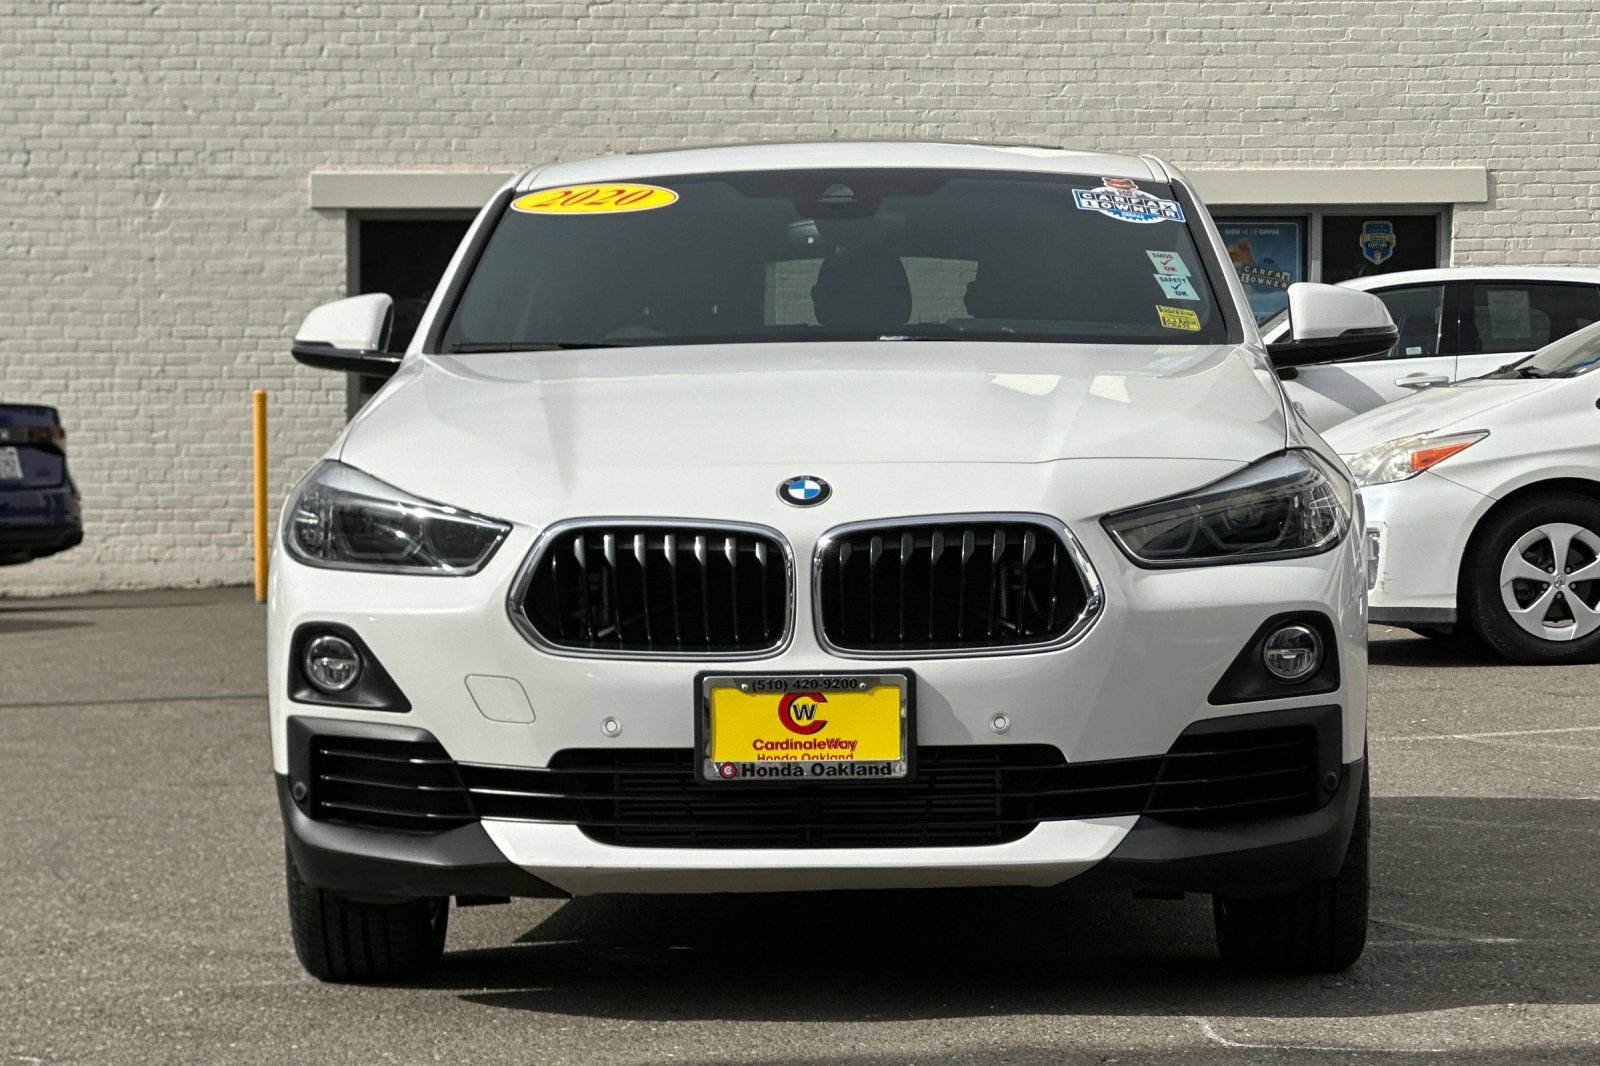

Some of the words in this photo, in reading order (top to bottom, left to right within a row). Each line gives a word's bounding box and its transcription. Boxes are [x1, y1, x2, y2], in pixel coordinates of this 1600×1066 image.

[530, 189, 655, 208] 2020
[1081, 193, 1173, 211] CARFAX
[1244, 265, 1291, 280] CARFAX
[752, 680, 789, 693] (510)
[793, 679, 858, 690] 420-9200
[752, 738, 859, 752] CardinaleWay
[741, 764, 805, 777] Honda
[811, 763, 893, 776] Oakland
